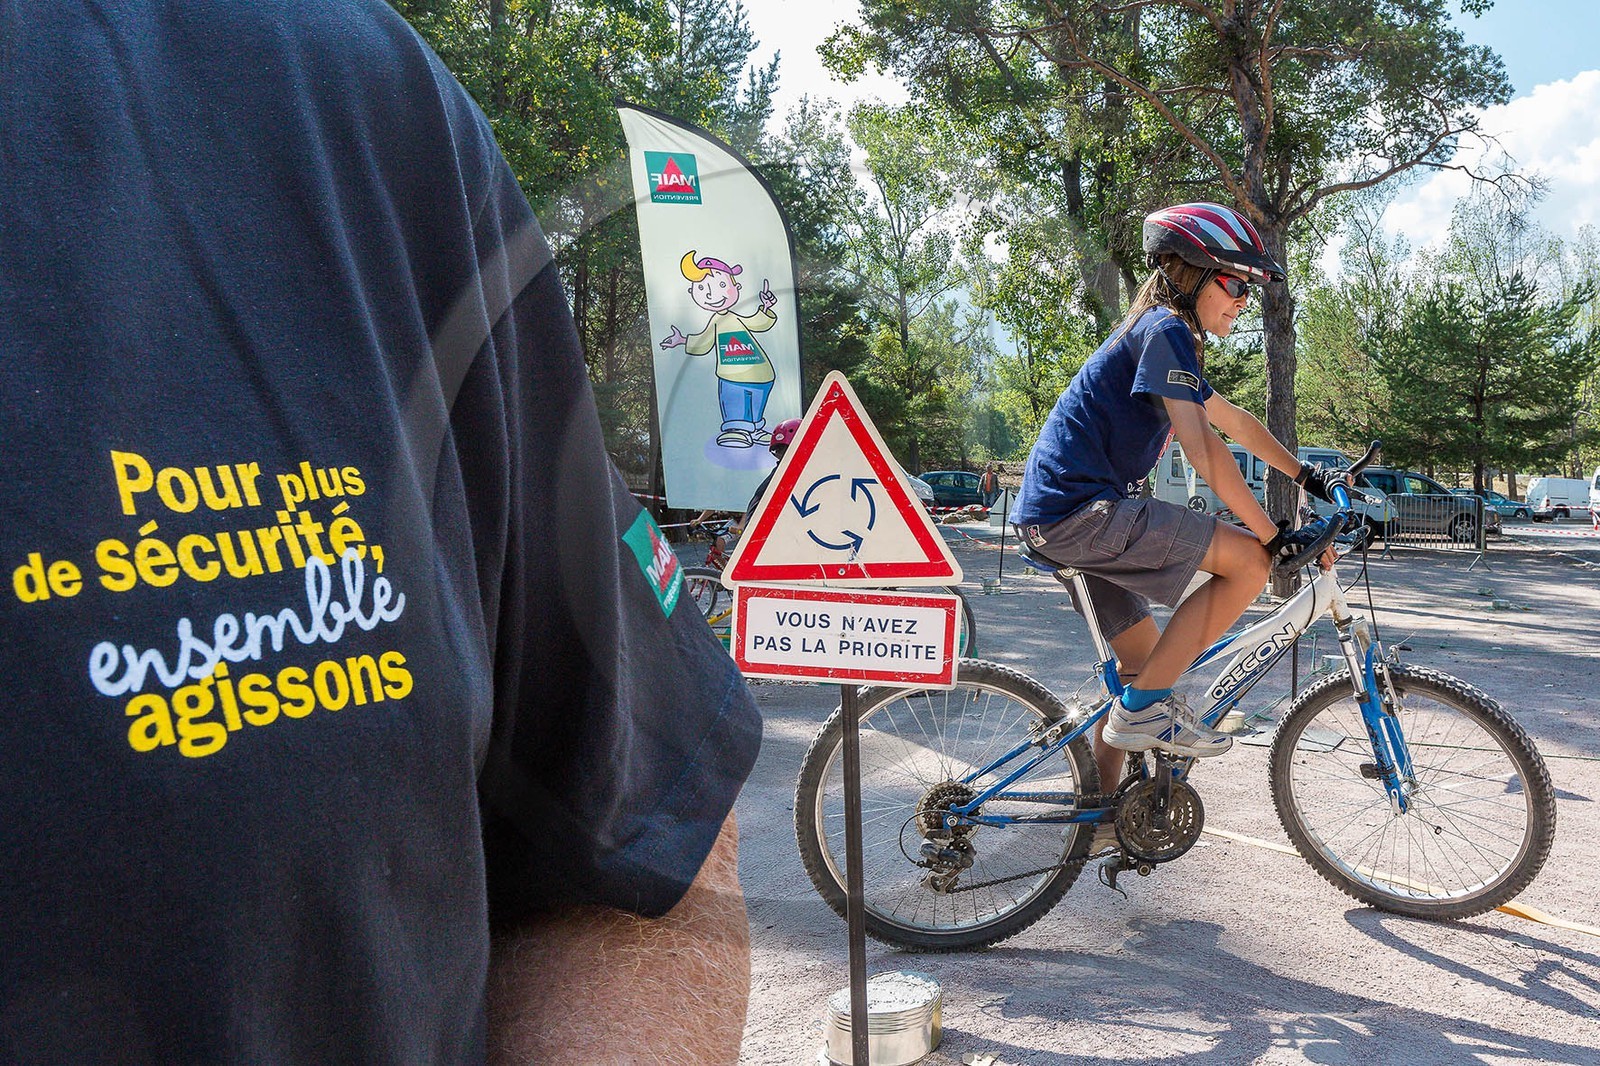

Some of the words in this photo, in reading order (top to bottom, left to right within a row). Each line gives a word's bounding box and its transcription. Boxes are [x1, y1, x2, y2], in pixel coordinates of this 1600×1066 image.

[110, 450, 261, 515] Pour
[277, 461, 366, 512] plus
[12, 552, 83, 603] de
[95, 501, 384, 592] sécurité,
[88, 546, 406, 697] ensemble
[753, 635, 792, 652] PAS
[801, 638, 826, 654] LA
[838, 640, 937, 661] PRIORITE
[776, 611, 831, 629] VOUS
[842, 615, 918, 635] N'AVEZ
[1211, 621, 1297, 700] OREGON
[124, 650, 413, 758] agissons
